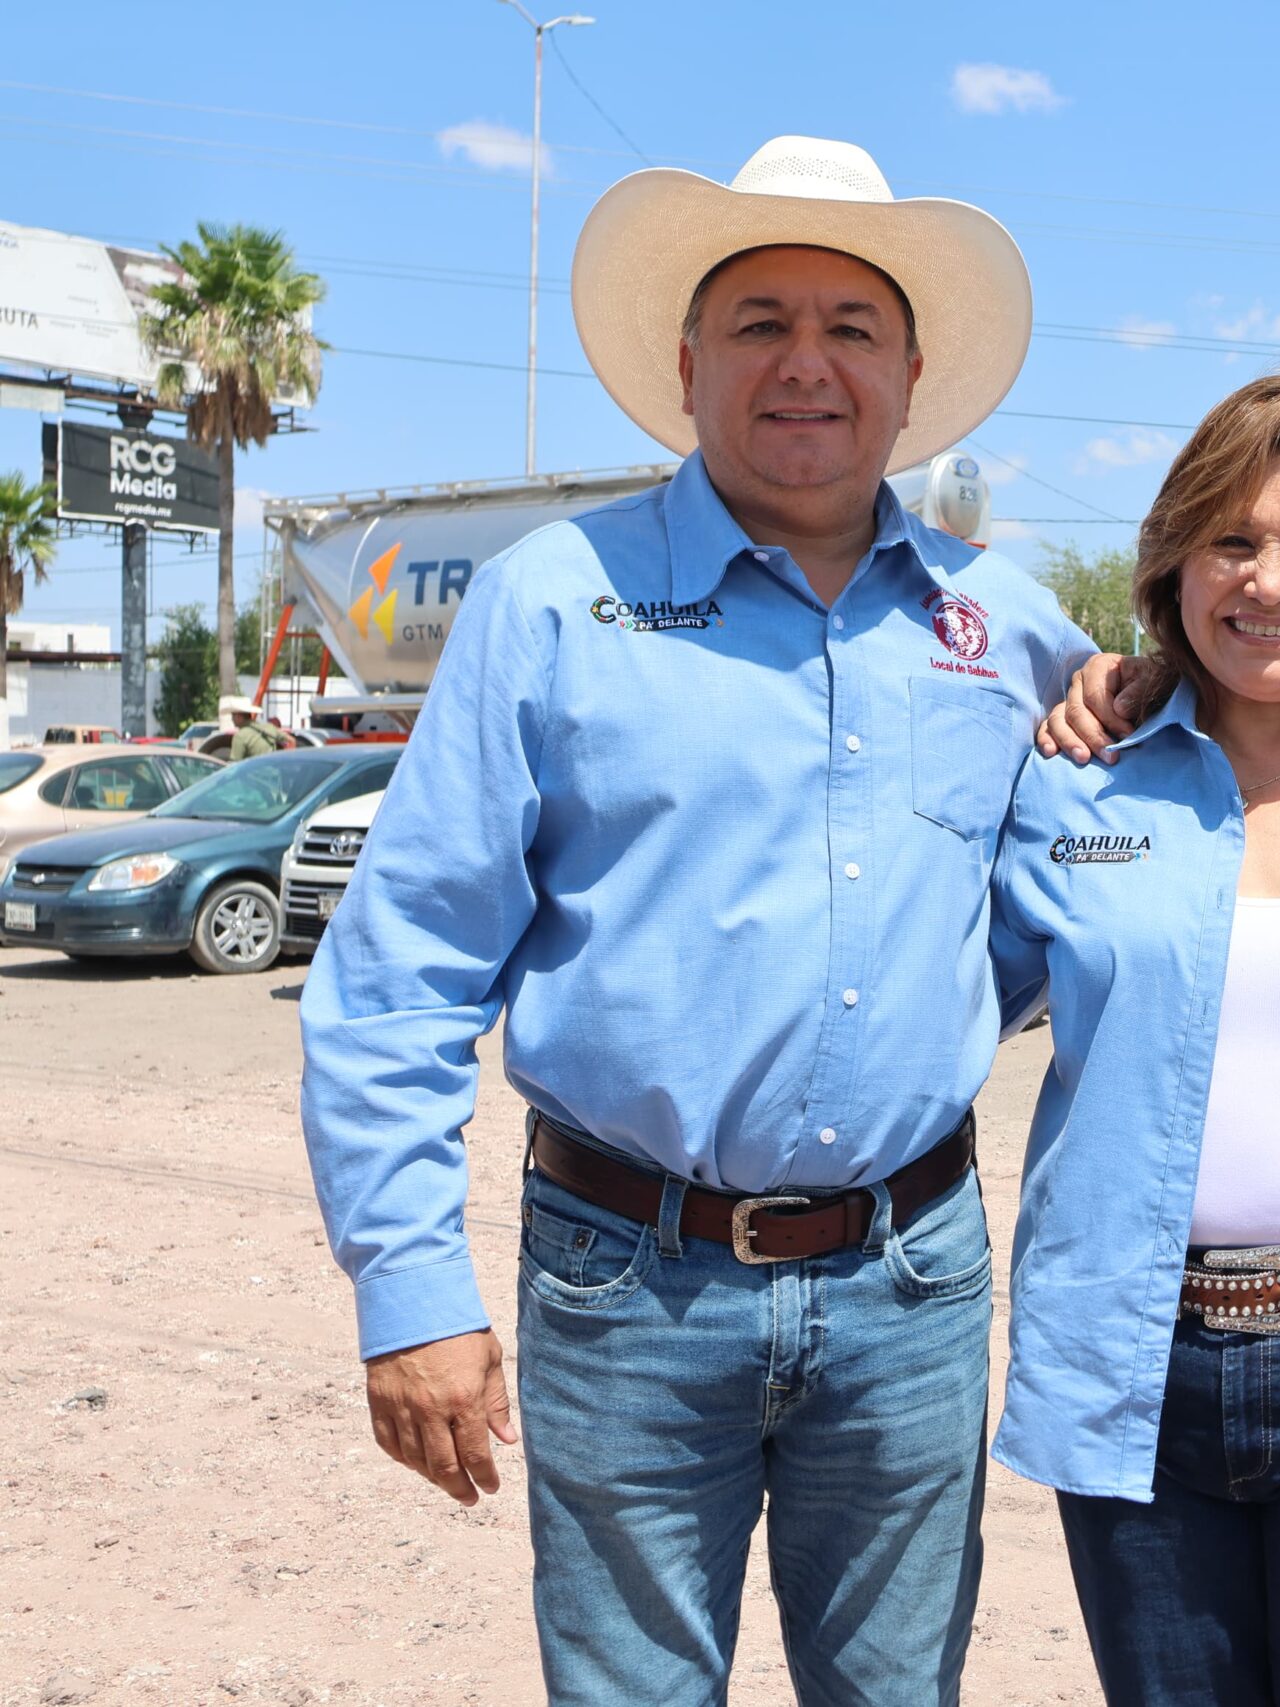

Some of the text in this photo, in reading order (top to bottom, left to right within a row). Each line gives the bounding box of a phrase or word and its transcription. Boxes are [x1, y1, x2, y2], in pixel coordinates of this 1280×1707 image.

[0, 307, 39, 329] UTA
[110, 435, 176, 477] RCG
[110, 470, 177, 500] Media
[407, 558, 473, 606] TR
[402, 623, 443, 642] GTM
[658, 617, 703, 629] DELANTE
[930, 657, 954, 672] Local
[955, 662, 967, 673] de
[1049, 834, 1151, 862] COAHUILA
[1091, 853, 1130, 861] DELANTE
